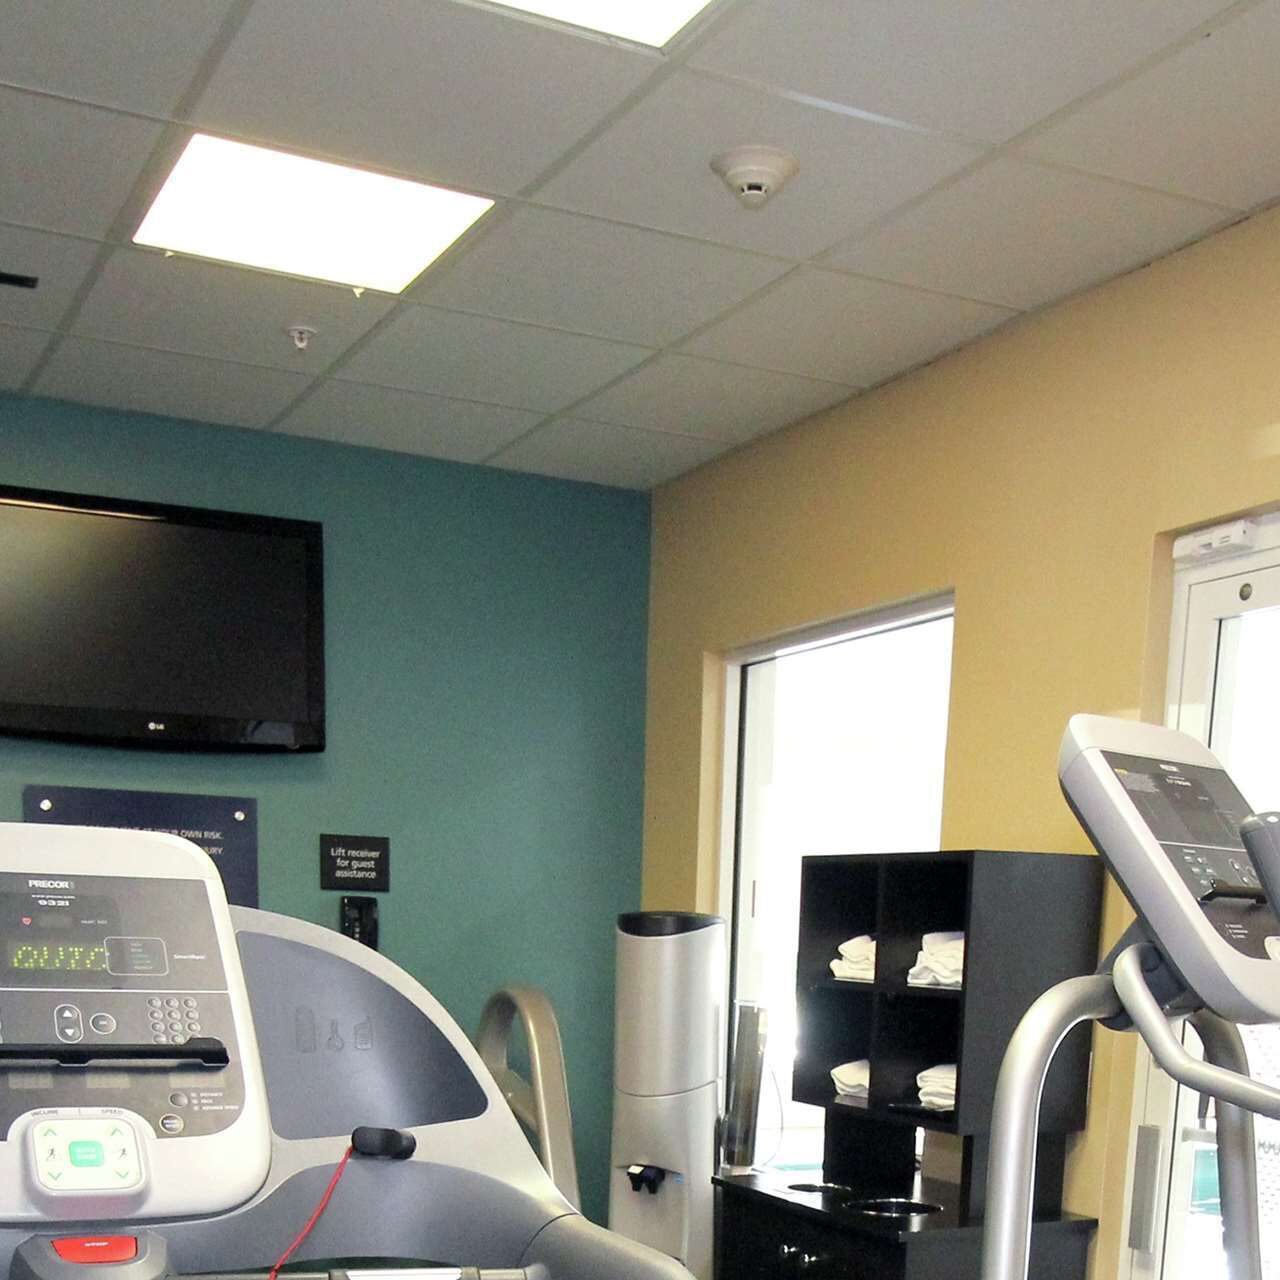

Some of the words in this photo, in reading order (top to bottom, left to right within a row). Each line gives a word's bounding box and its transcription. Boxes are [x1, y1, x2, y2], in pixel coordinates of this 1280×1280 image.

[180, 829, 203, 839] OWN
[330, 847, 346, 857] Lift
[347, 849, 381, 858] receiver
[336, 857, 349, 867] for
[351, 860, 375, 870] guest
[335, 869, 377, 879] assistance
[28, 880, 70, 889] PRECOR
